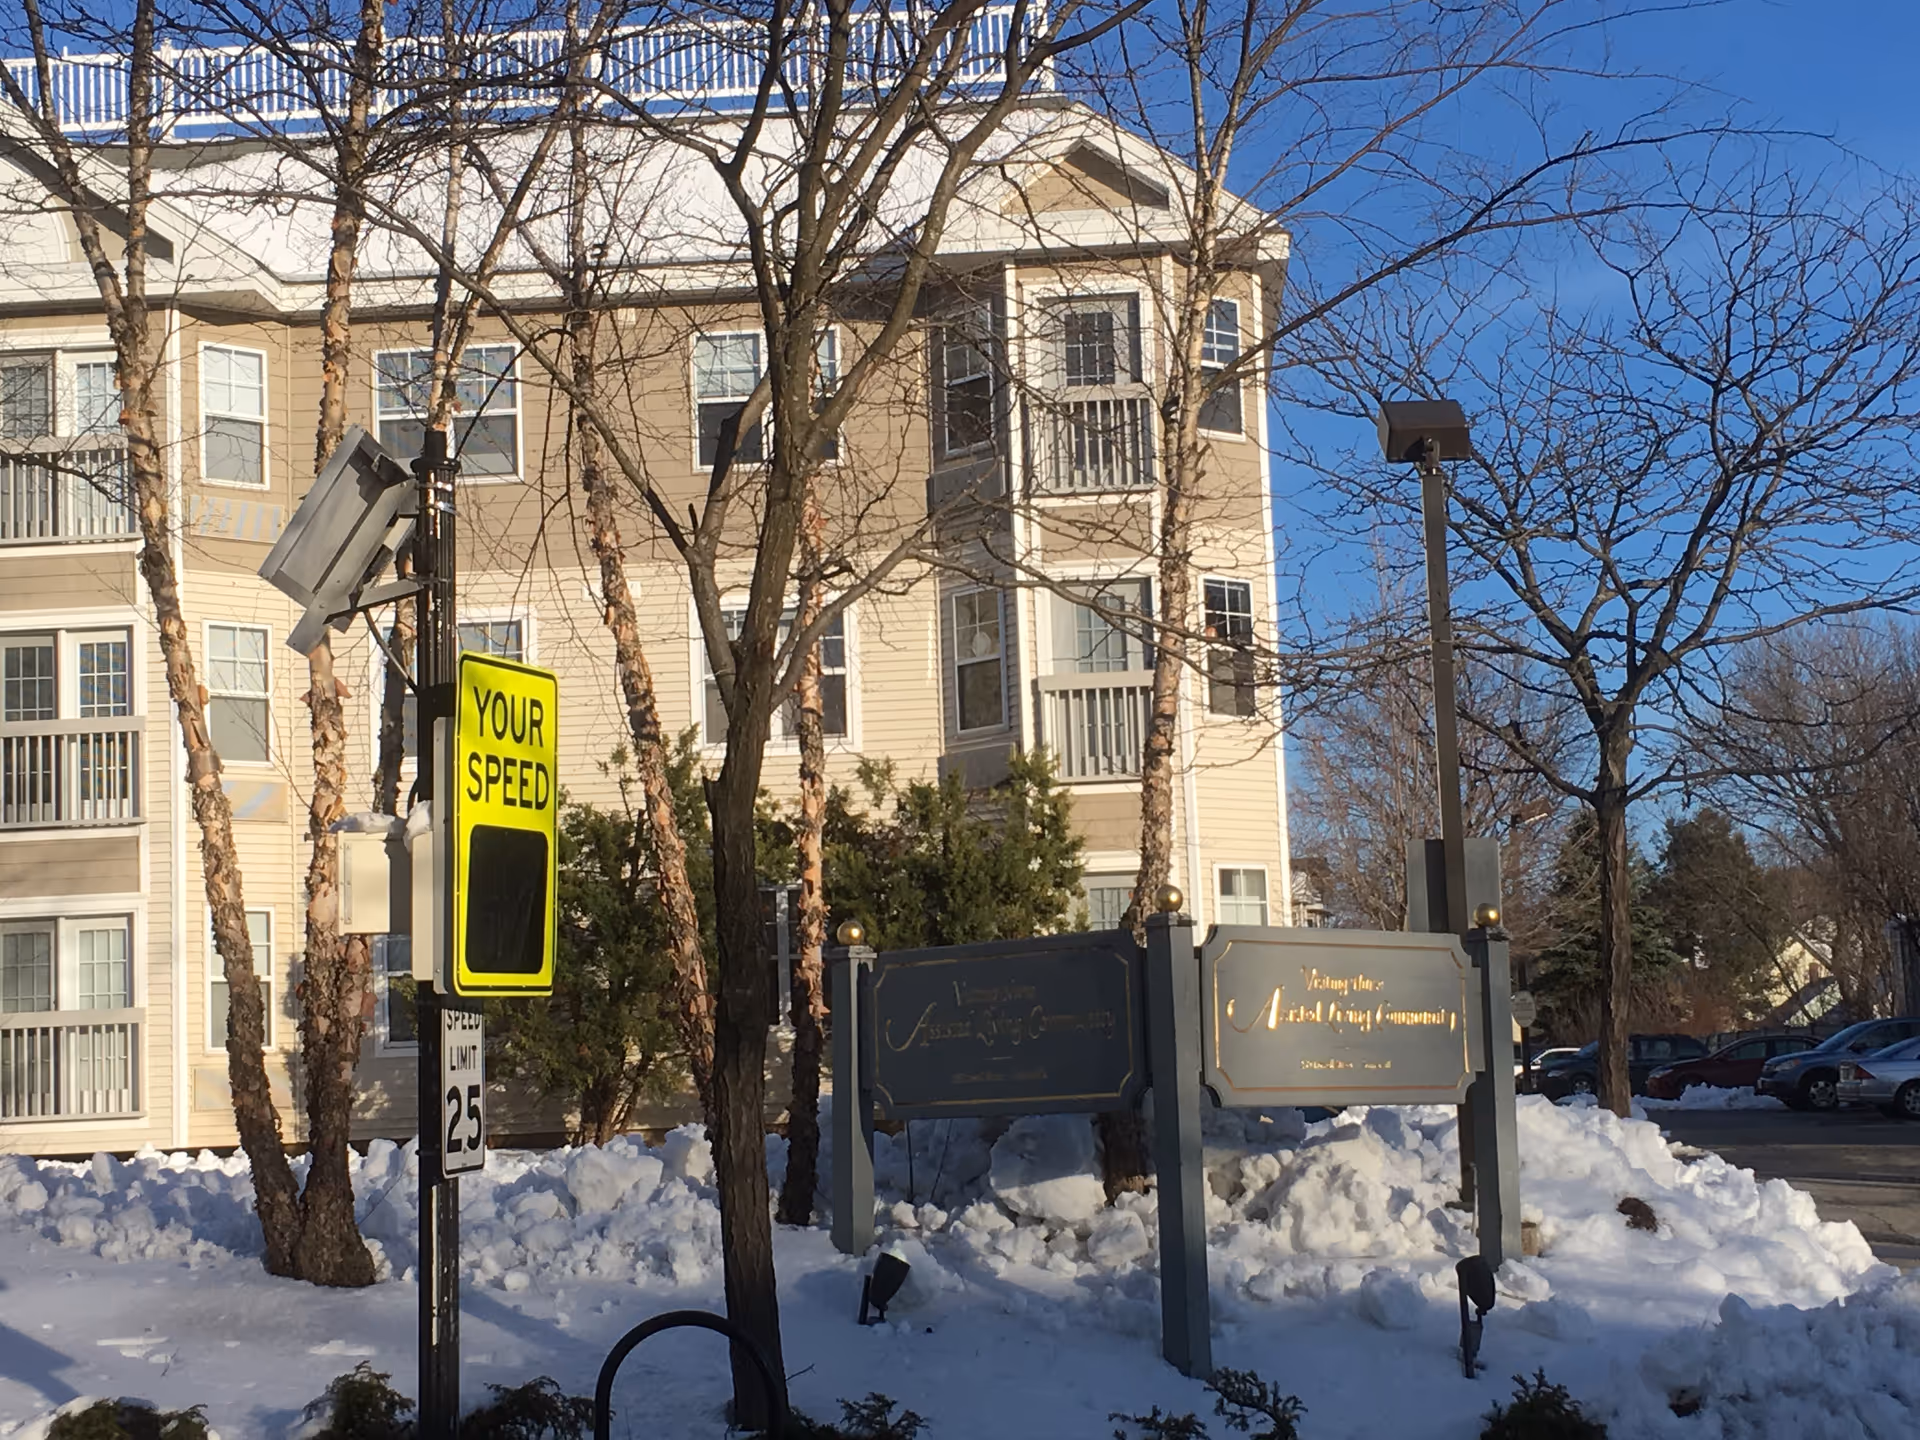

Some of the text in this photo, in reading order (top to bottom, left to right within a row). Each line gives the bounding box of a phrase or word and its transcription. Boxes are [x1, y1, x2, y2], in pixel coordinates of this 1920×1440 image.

[473, 686, 544, 748] YOUR
[466, 752, 550, 811] SPEED
[446, 1010, 481, 1031] SPEED
[450, 1045, 478, 1071] LIMIT
[446, 1084, 482, 1154] 25
